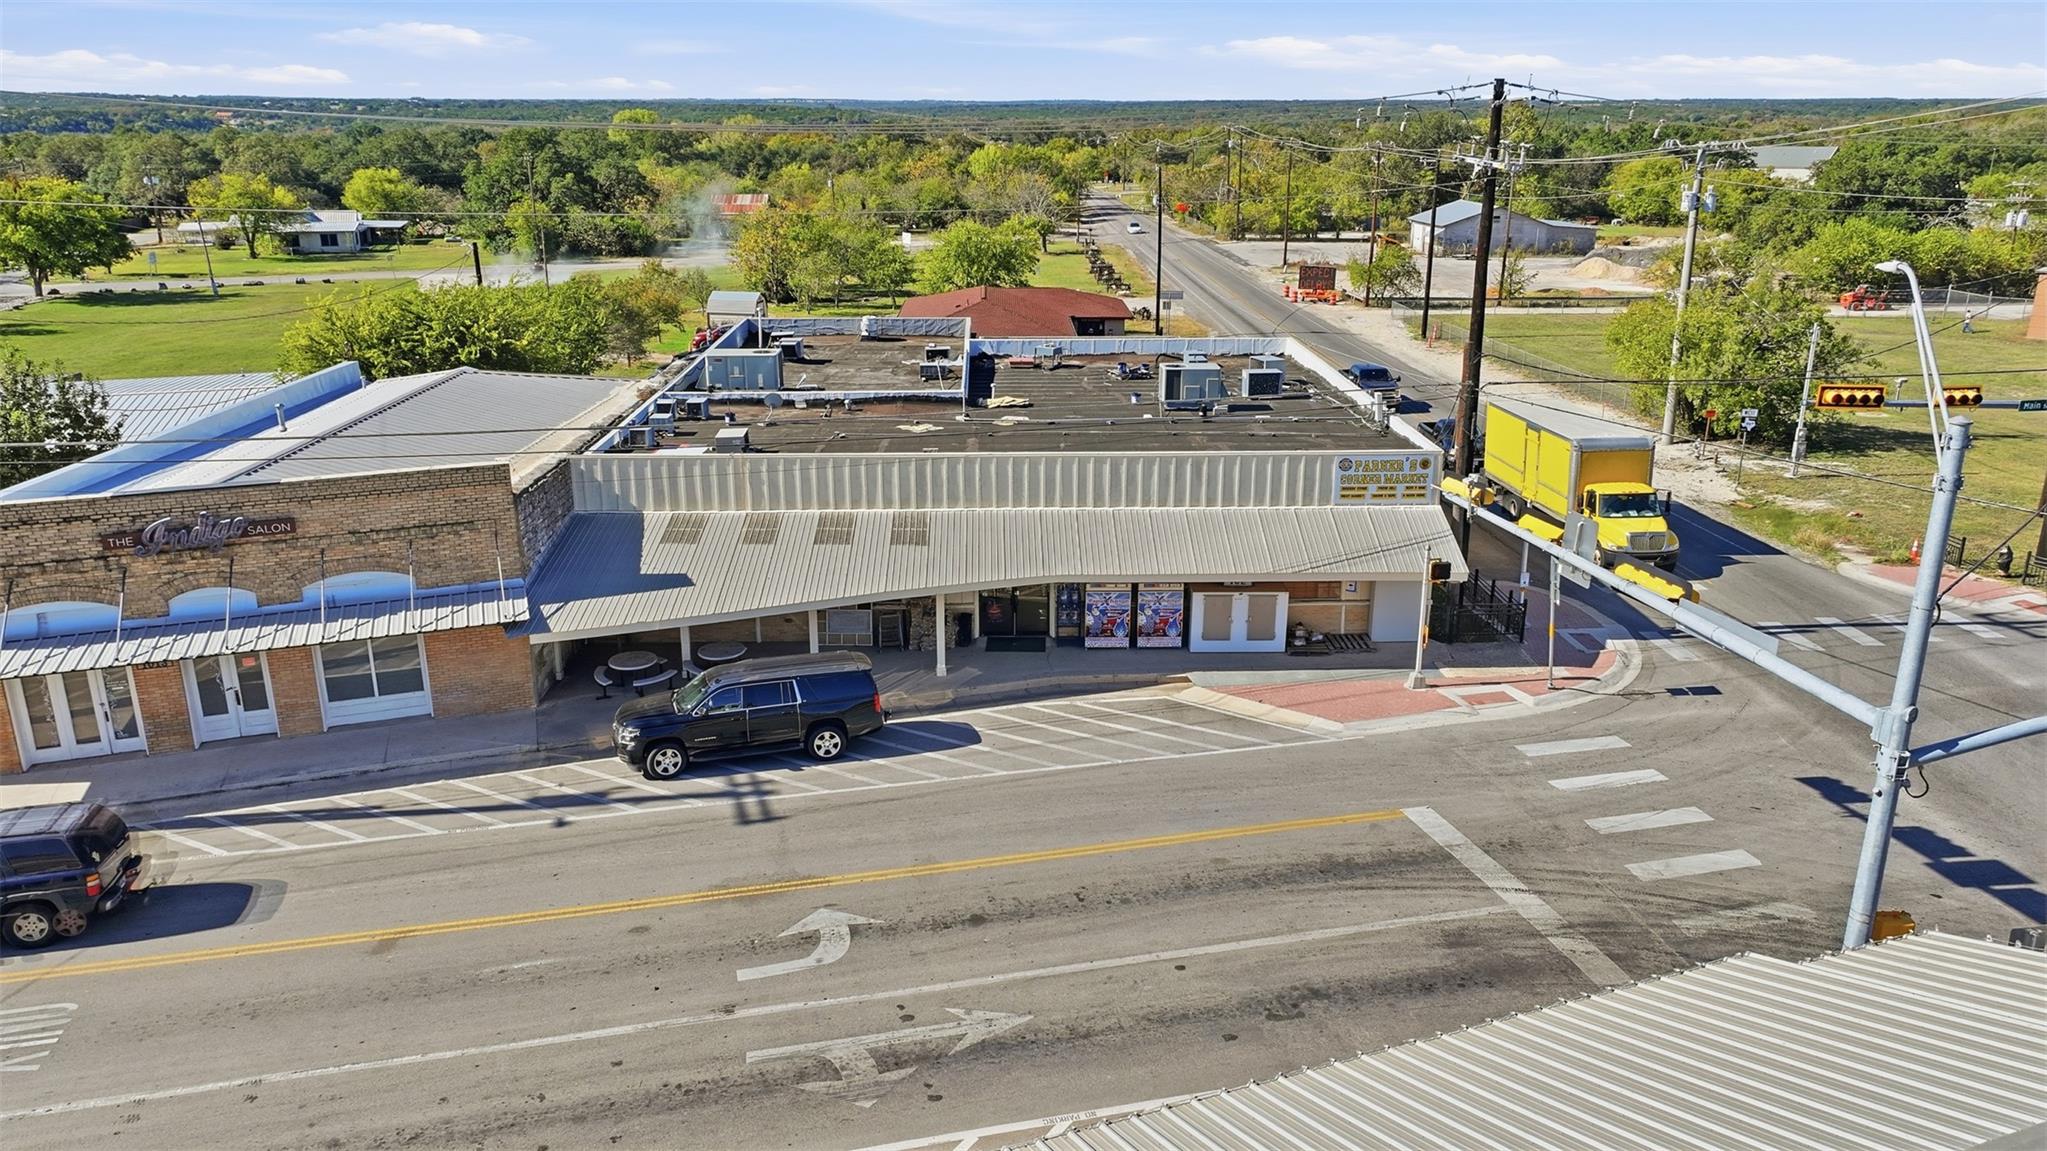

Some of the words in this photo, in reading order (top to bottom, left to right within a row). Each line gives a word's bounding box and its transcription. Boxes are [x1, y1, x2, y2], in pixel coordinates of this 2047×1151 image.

[1301, 267, 1334, 278] EXPECT
[2023, 402, 2041, 410] Main
[1340, 473, 1382, 484] CORNER
[1383, 473, 1428, 484] MARKET
[107, 536, 135, 549] THE
[134, 511, 248, 557] Indigo
[247, 522, 291, 535] SALON
